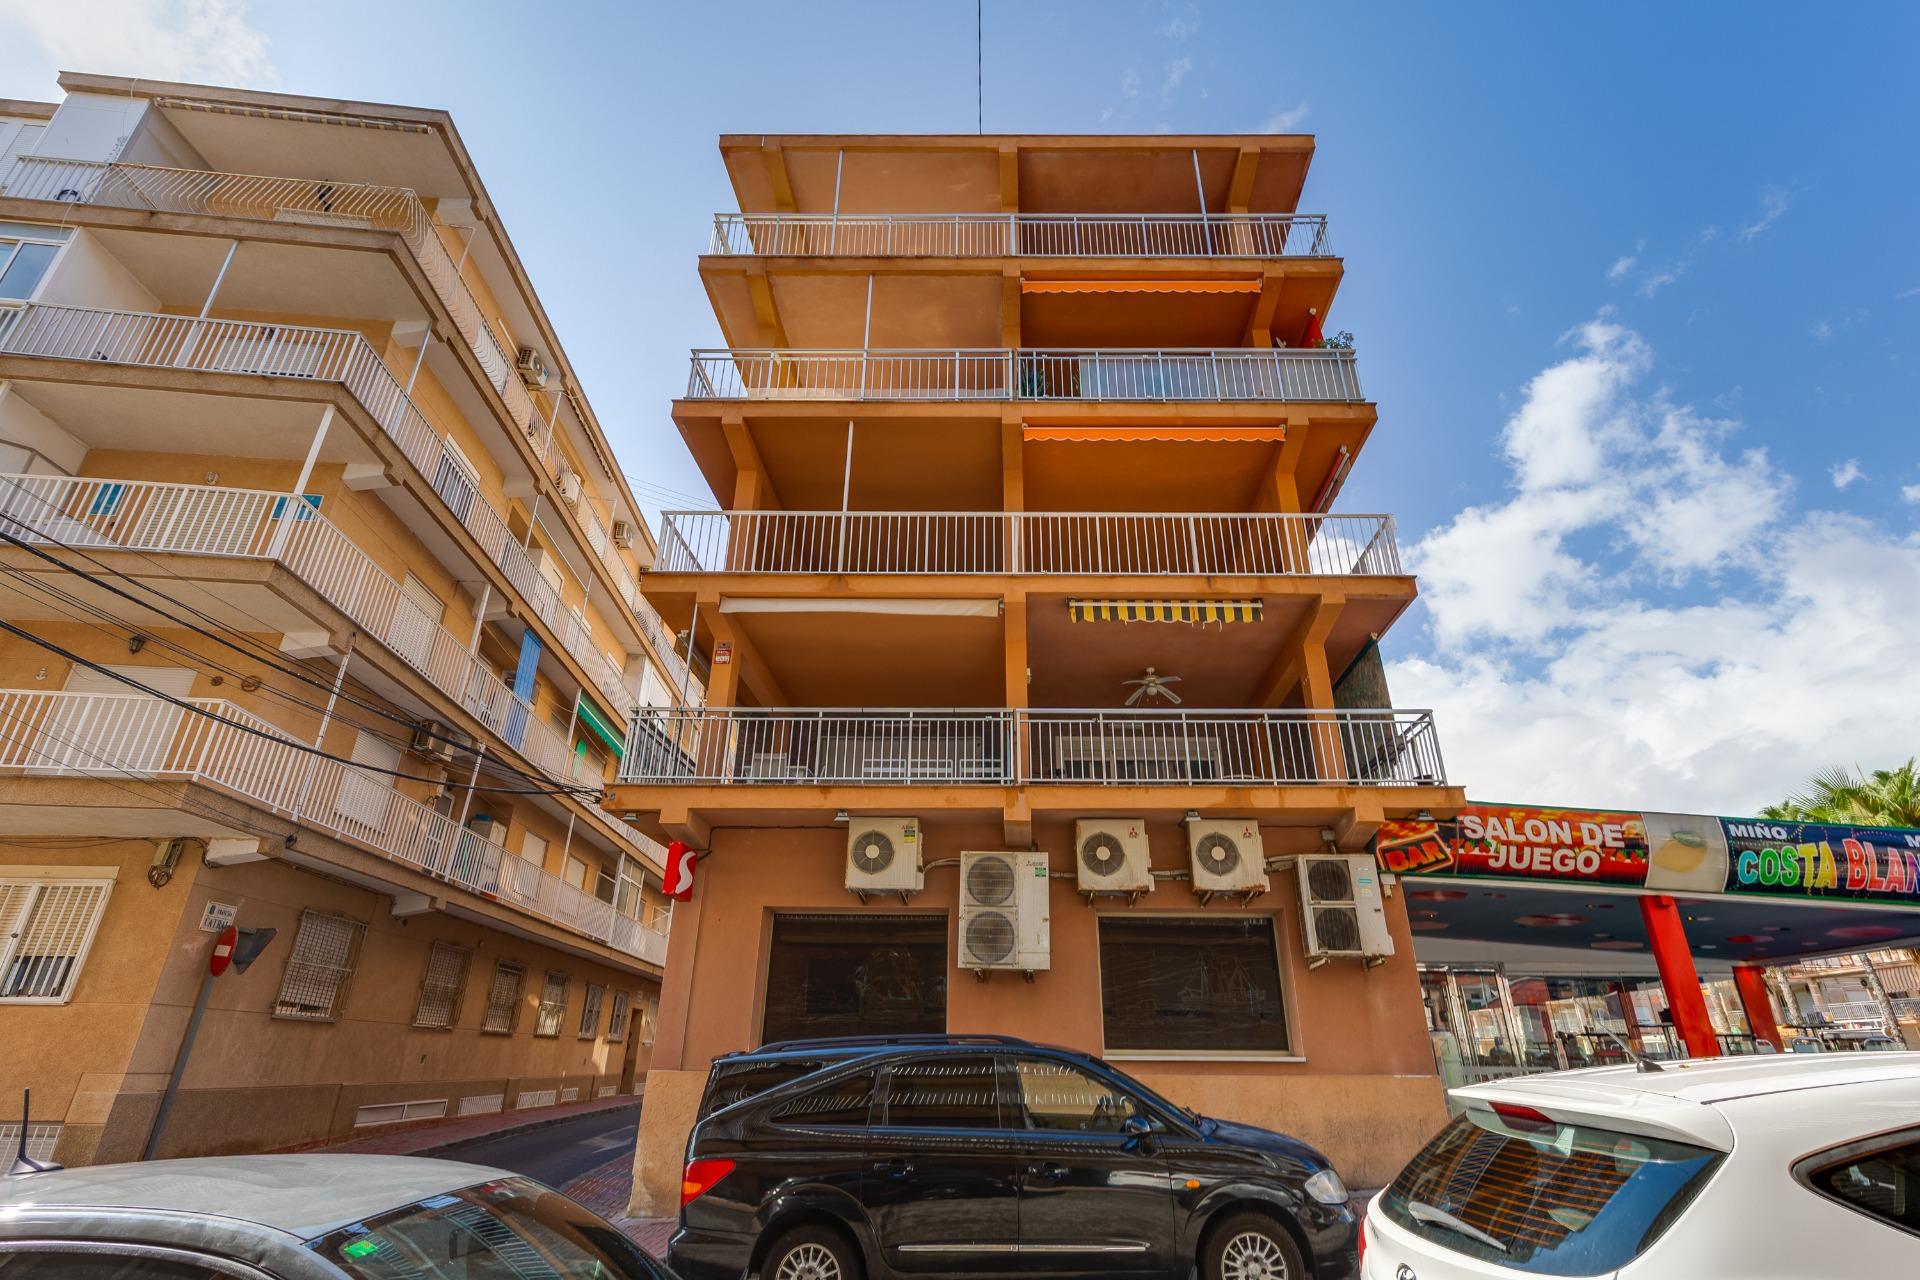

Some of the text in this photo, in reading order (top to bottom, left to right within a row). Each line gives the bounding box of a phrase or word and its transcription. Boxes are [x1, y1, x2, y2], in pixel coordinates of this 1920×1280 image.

[1463, 815, 1625, 848] SALON DE
[1728, 823, 1787, 840] MIÑO
[1385, 841, 1446, 872] BAR
[1488, 845, 1600, 874] JUEGO
[1738, 841, 1838, 889] COSTA
